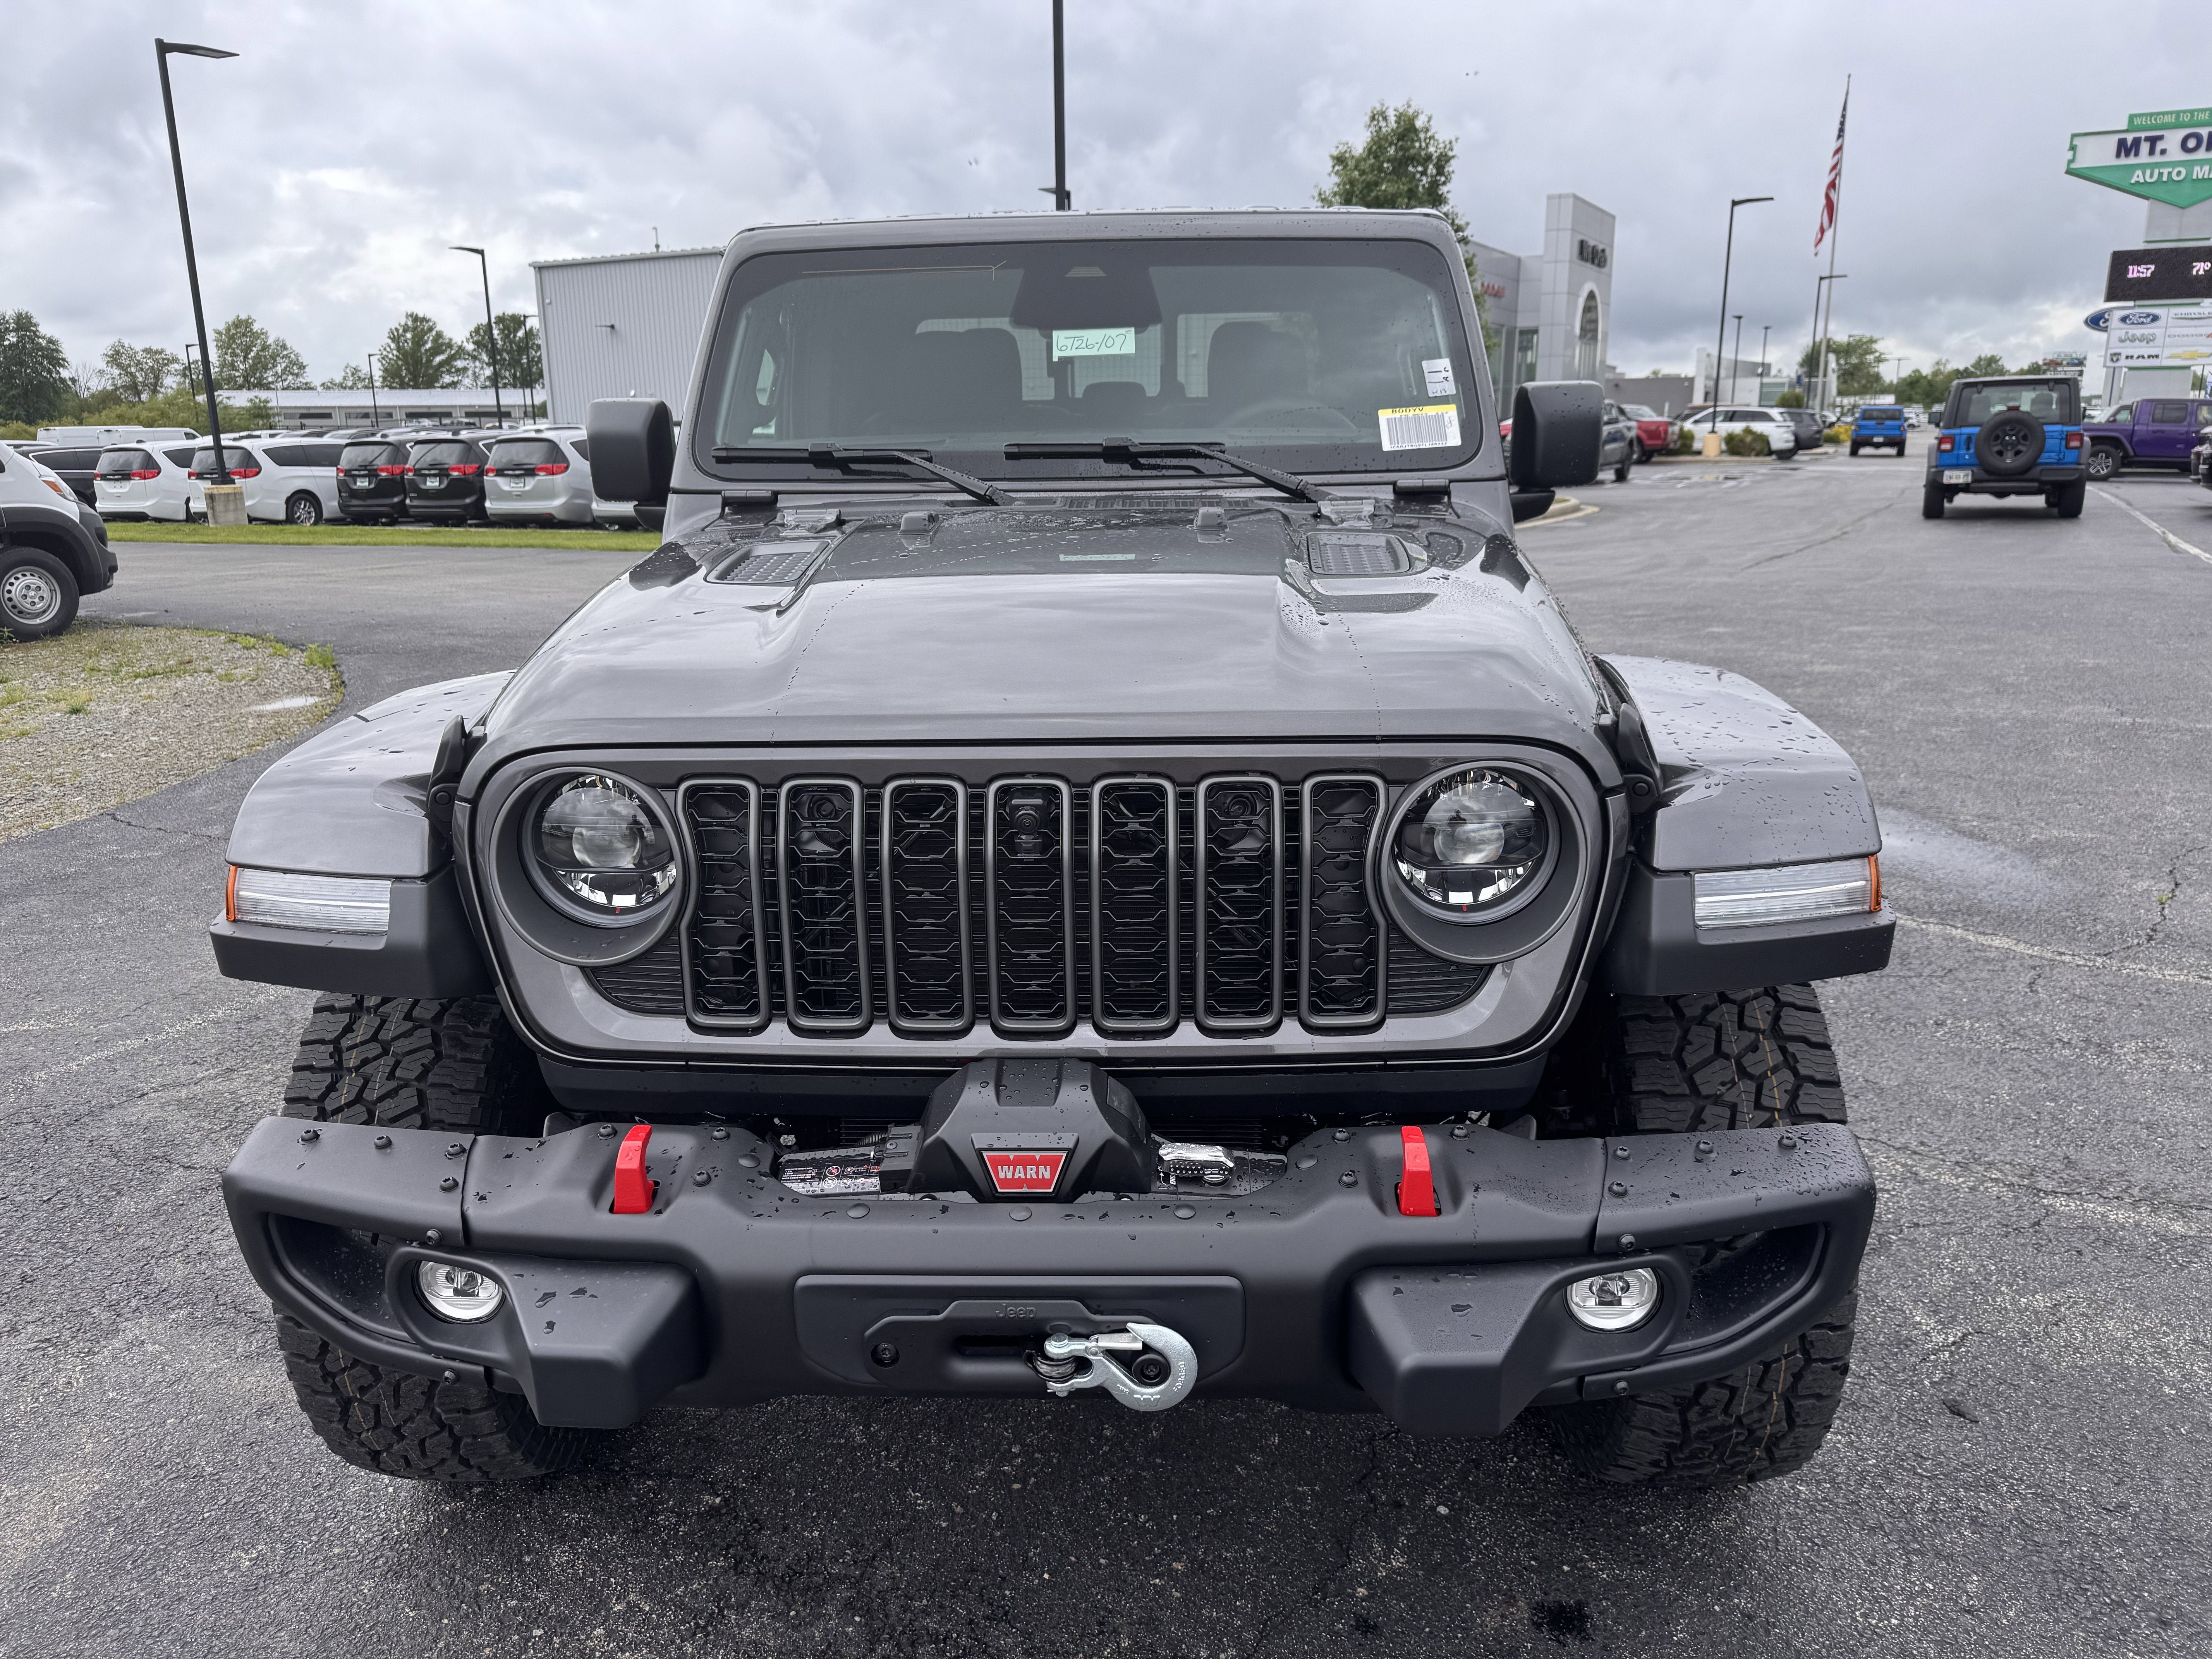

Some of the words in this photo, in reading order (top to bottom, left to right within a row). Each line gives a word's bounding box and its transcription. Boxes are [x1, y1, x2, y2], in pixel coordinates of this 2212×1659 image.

[2134, 114, 2176, 125] WELCOME
[2180, 113, 2191, 121] TO
[2194, 111, 2210, 120] THE
[2116, 134, 2167, 158] MT.
[2130, 167, 2186, 184] AUTO
[2127, 264, 2155, 278] 11:57
[2126, 313, 2153, 324] Ford
[2118, 331, 2157, 344] Jeep
[998, 1165, 1050, 1179] WARN
[996, 1304, 1036, 1319] Jeep
